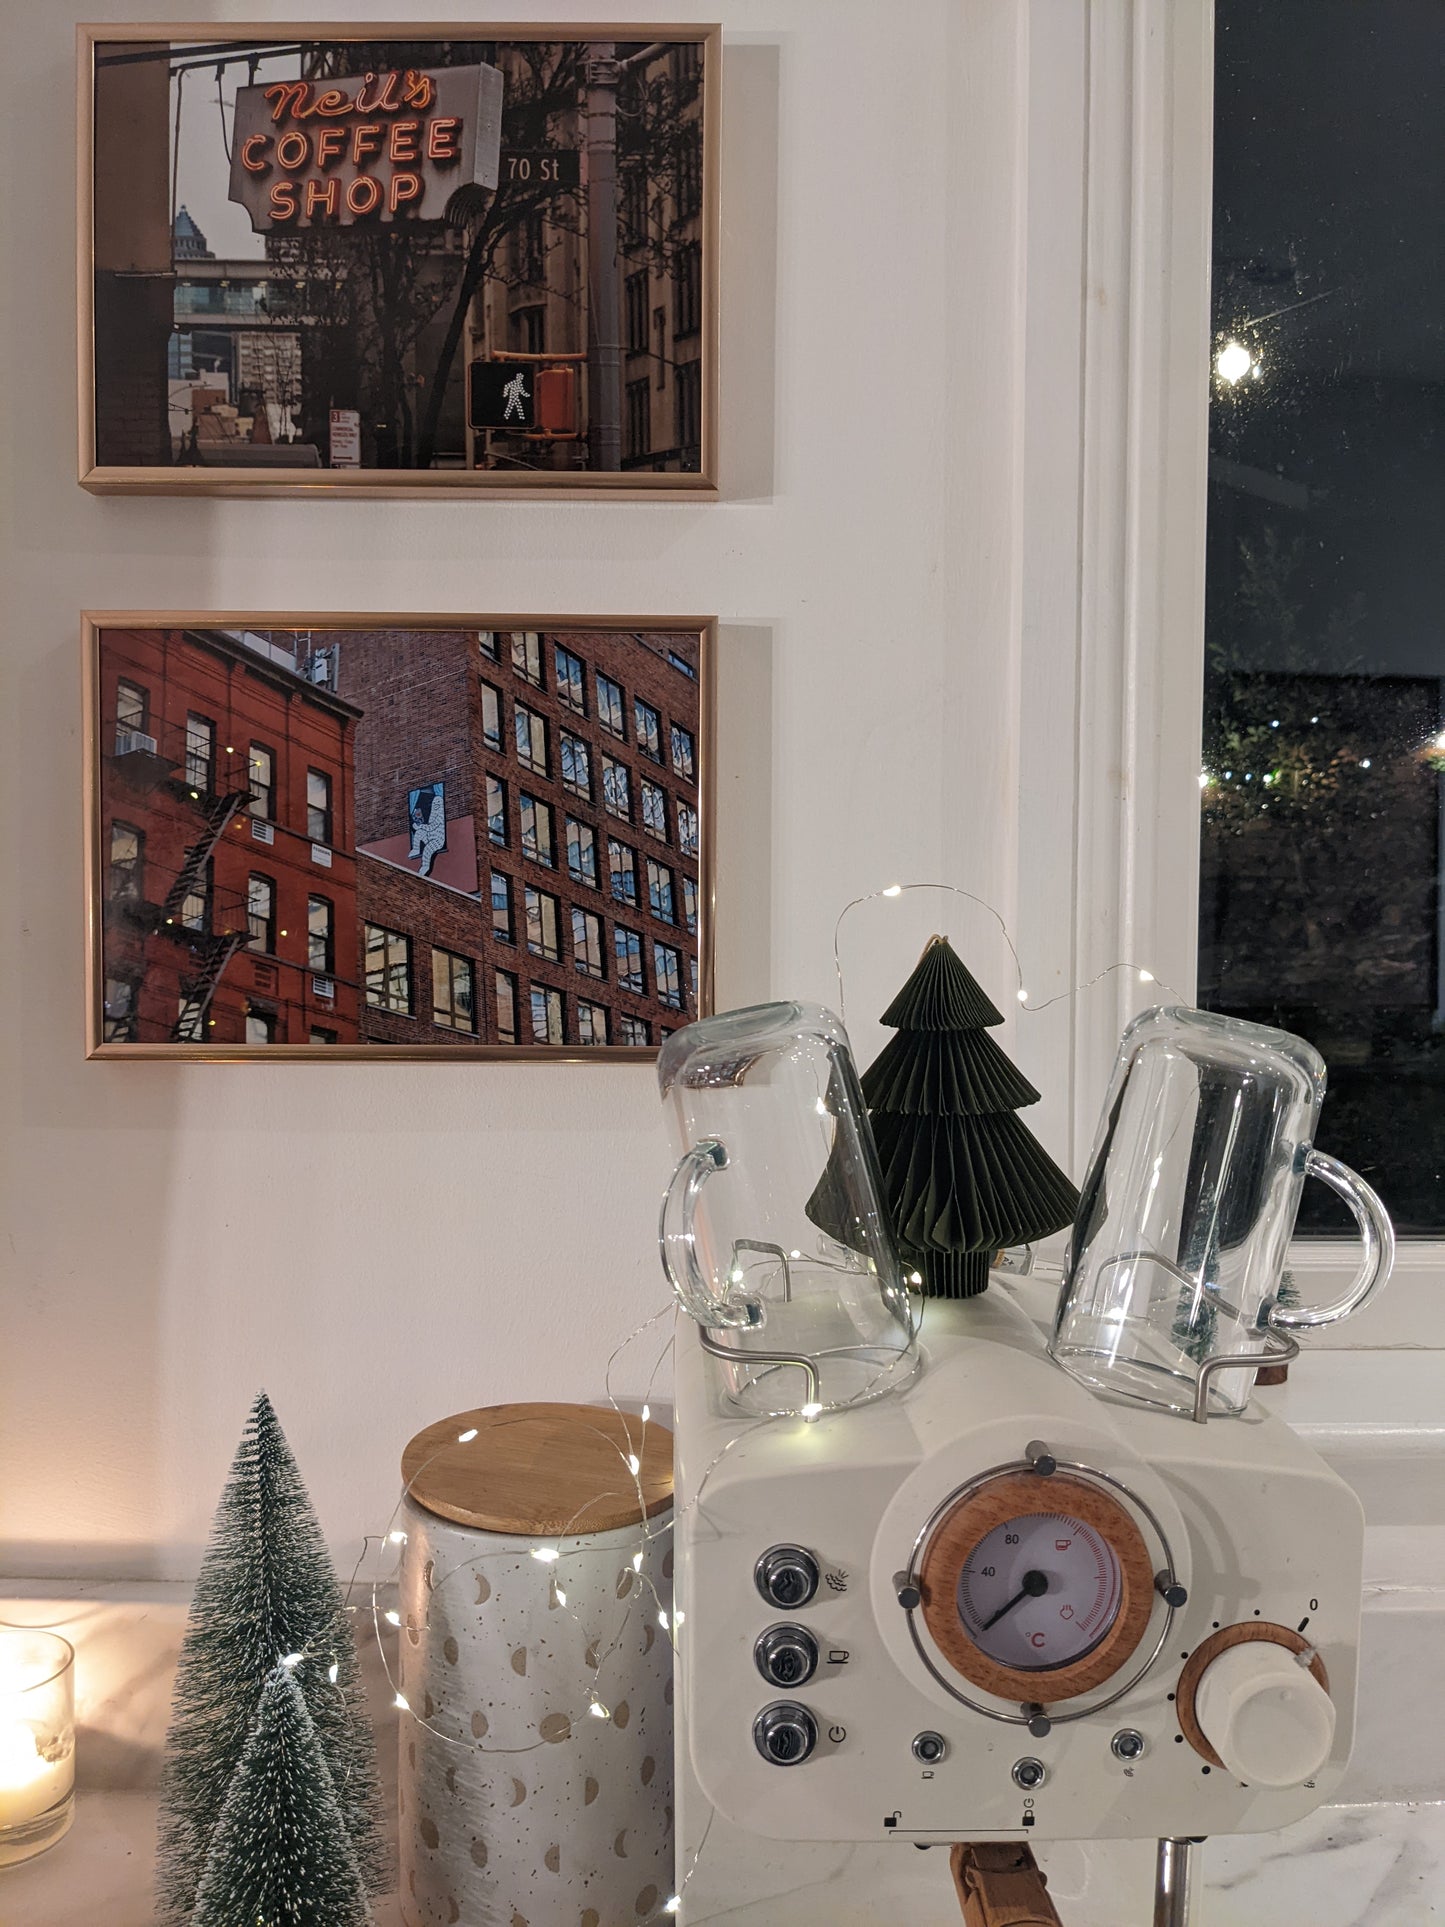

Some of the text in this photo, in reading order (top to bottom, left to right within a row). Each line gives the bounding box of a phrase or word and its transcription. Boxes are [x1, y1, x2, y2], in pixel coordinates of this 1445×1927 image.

[241, 117, 460, 172] COFFEE
[507, 158, 560, 181] 70 St
[268, 172, 422, 220] SHOP
[1005, 1534, 1019, 1545] 80
[981, 1566, 996, 1577] 40
